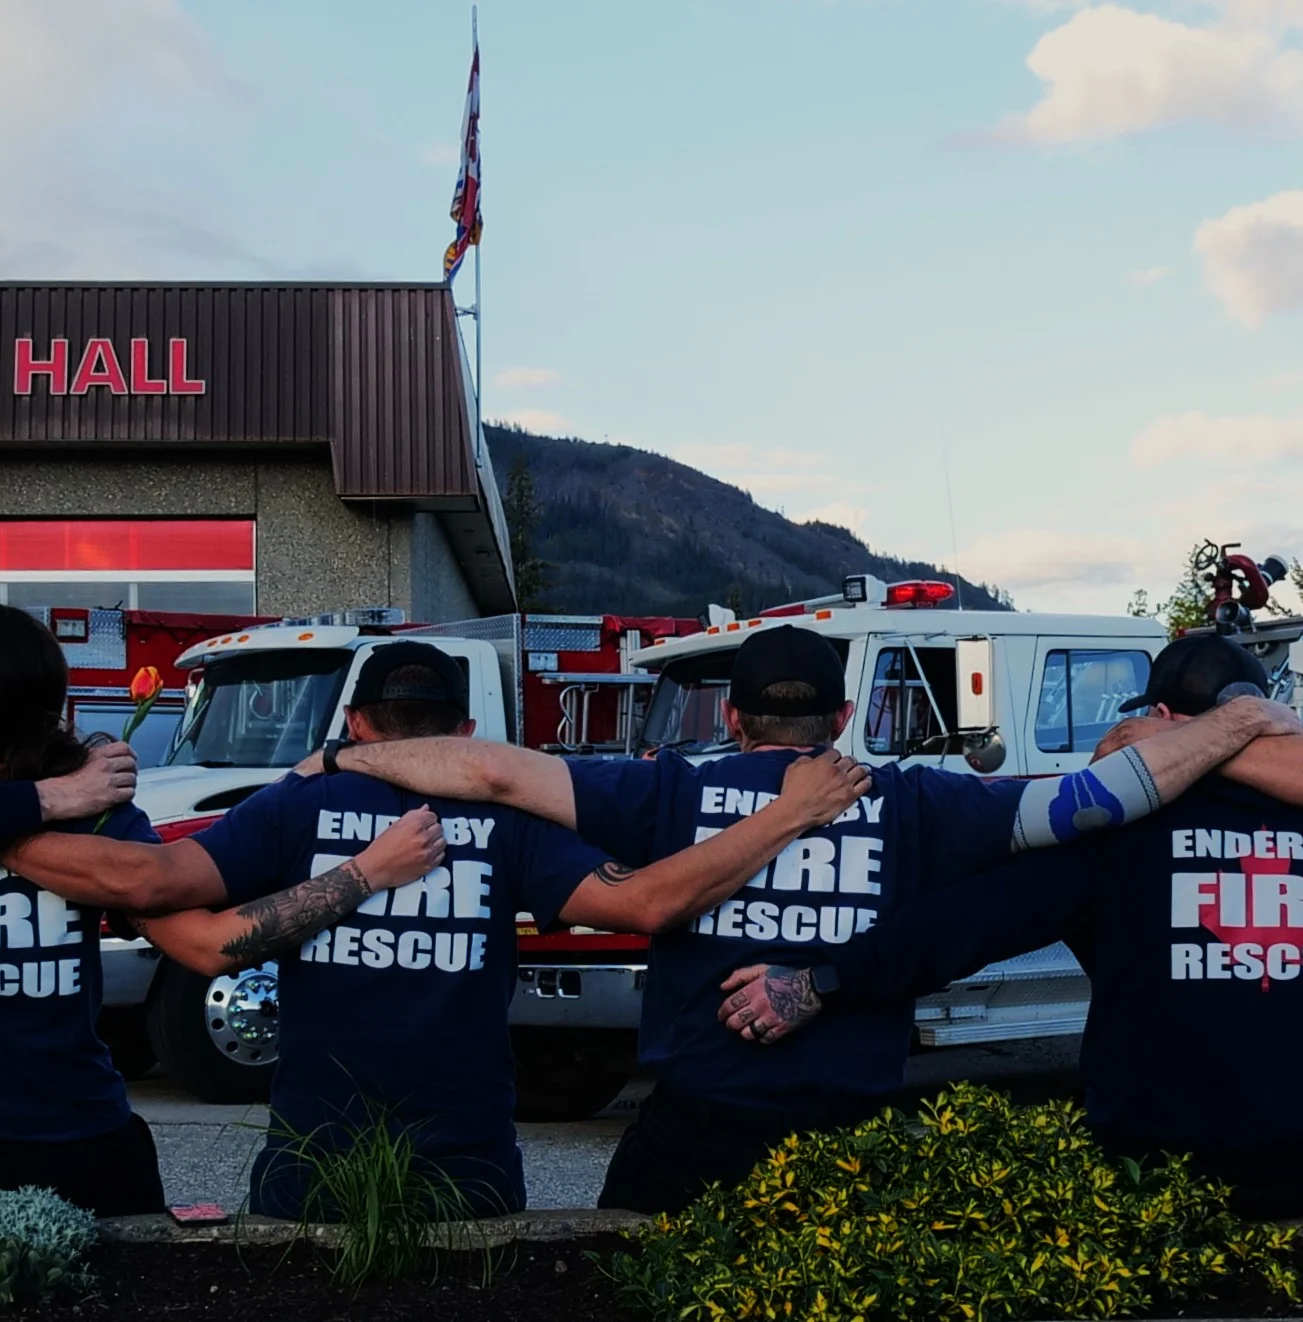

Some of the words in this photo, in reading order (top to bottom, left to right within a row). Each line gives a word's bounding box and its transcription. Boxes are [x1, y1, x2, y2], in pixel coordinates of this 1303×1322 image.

[13, 337, 206, 396] HALL
[316, 809, 496, 849] ENBY
[700, 785, 884, 828] ENBY
[310, 853, 493, 919] RE
[694, 826, 884, 896] RE
[300, 925, 488, 972] RESCUE
